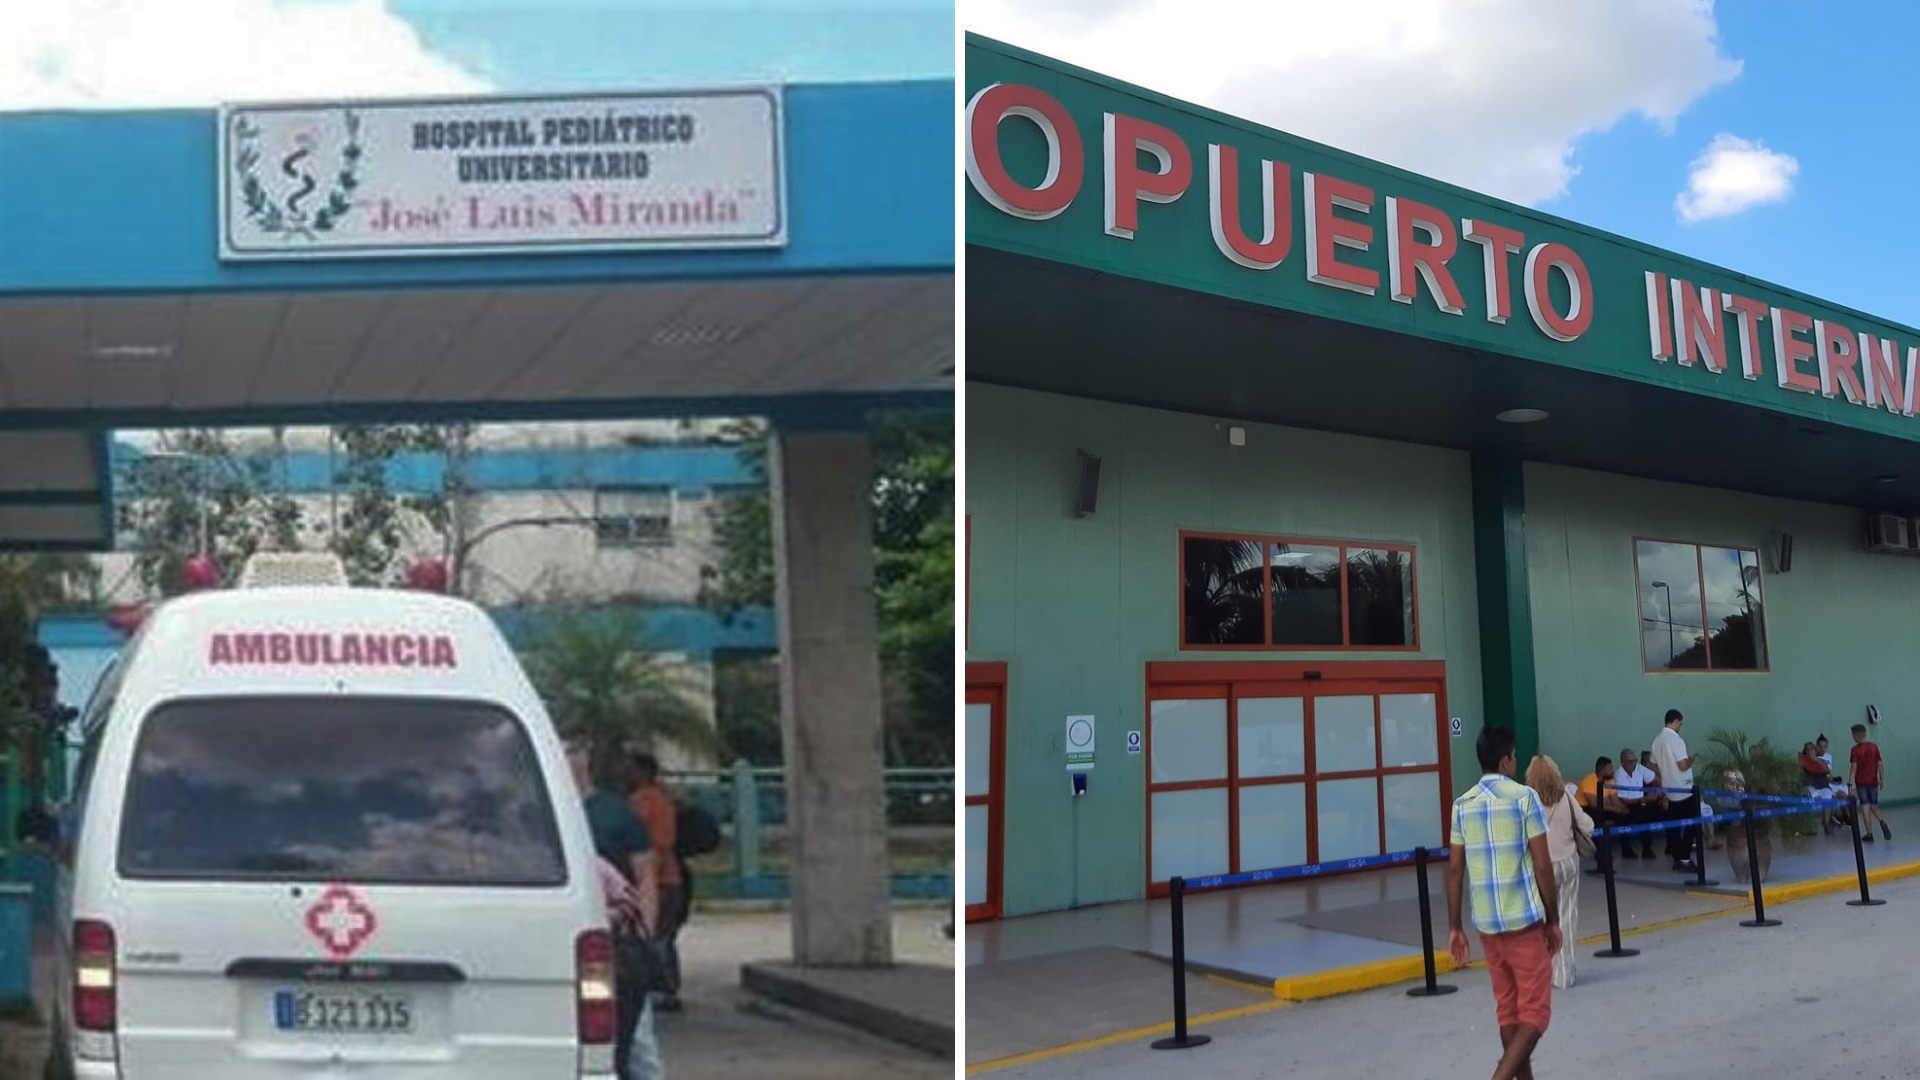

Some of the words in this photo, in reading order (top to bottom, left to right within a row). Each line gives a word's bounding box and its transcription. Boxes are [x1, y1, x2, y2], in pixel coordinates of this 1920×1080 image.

[413, 119, 536, 150] HOSPITAL
[541, 112, 694, 145] PEDIÁTRICO
[457, 151, 650, 183] UNIVERSITARIO
[467, 196, 559, 229] Luis
[209, 632, 457, 668] AMBULANCIA
